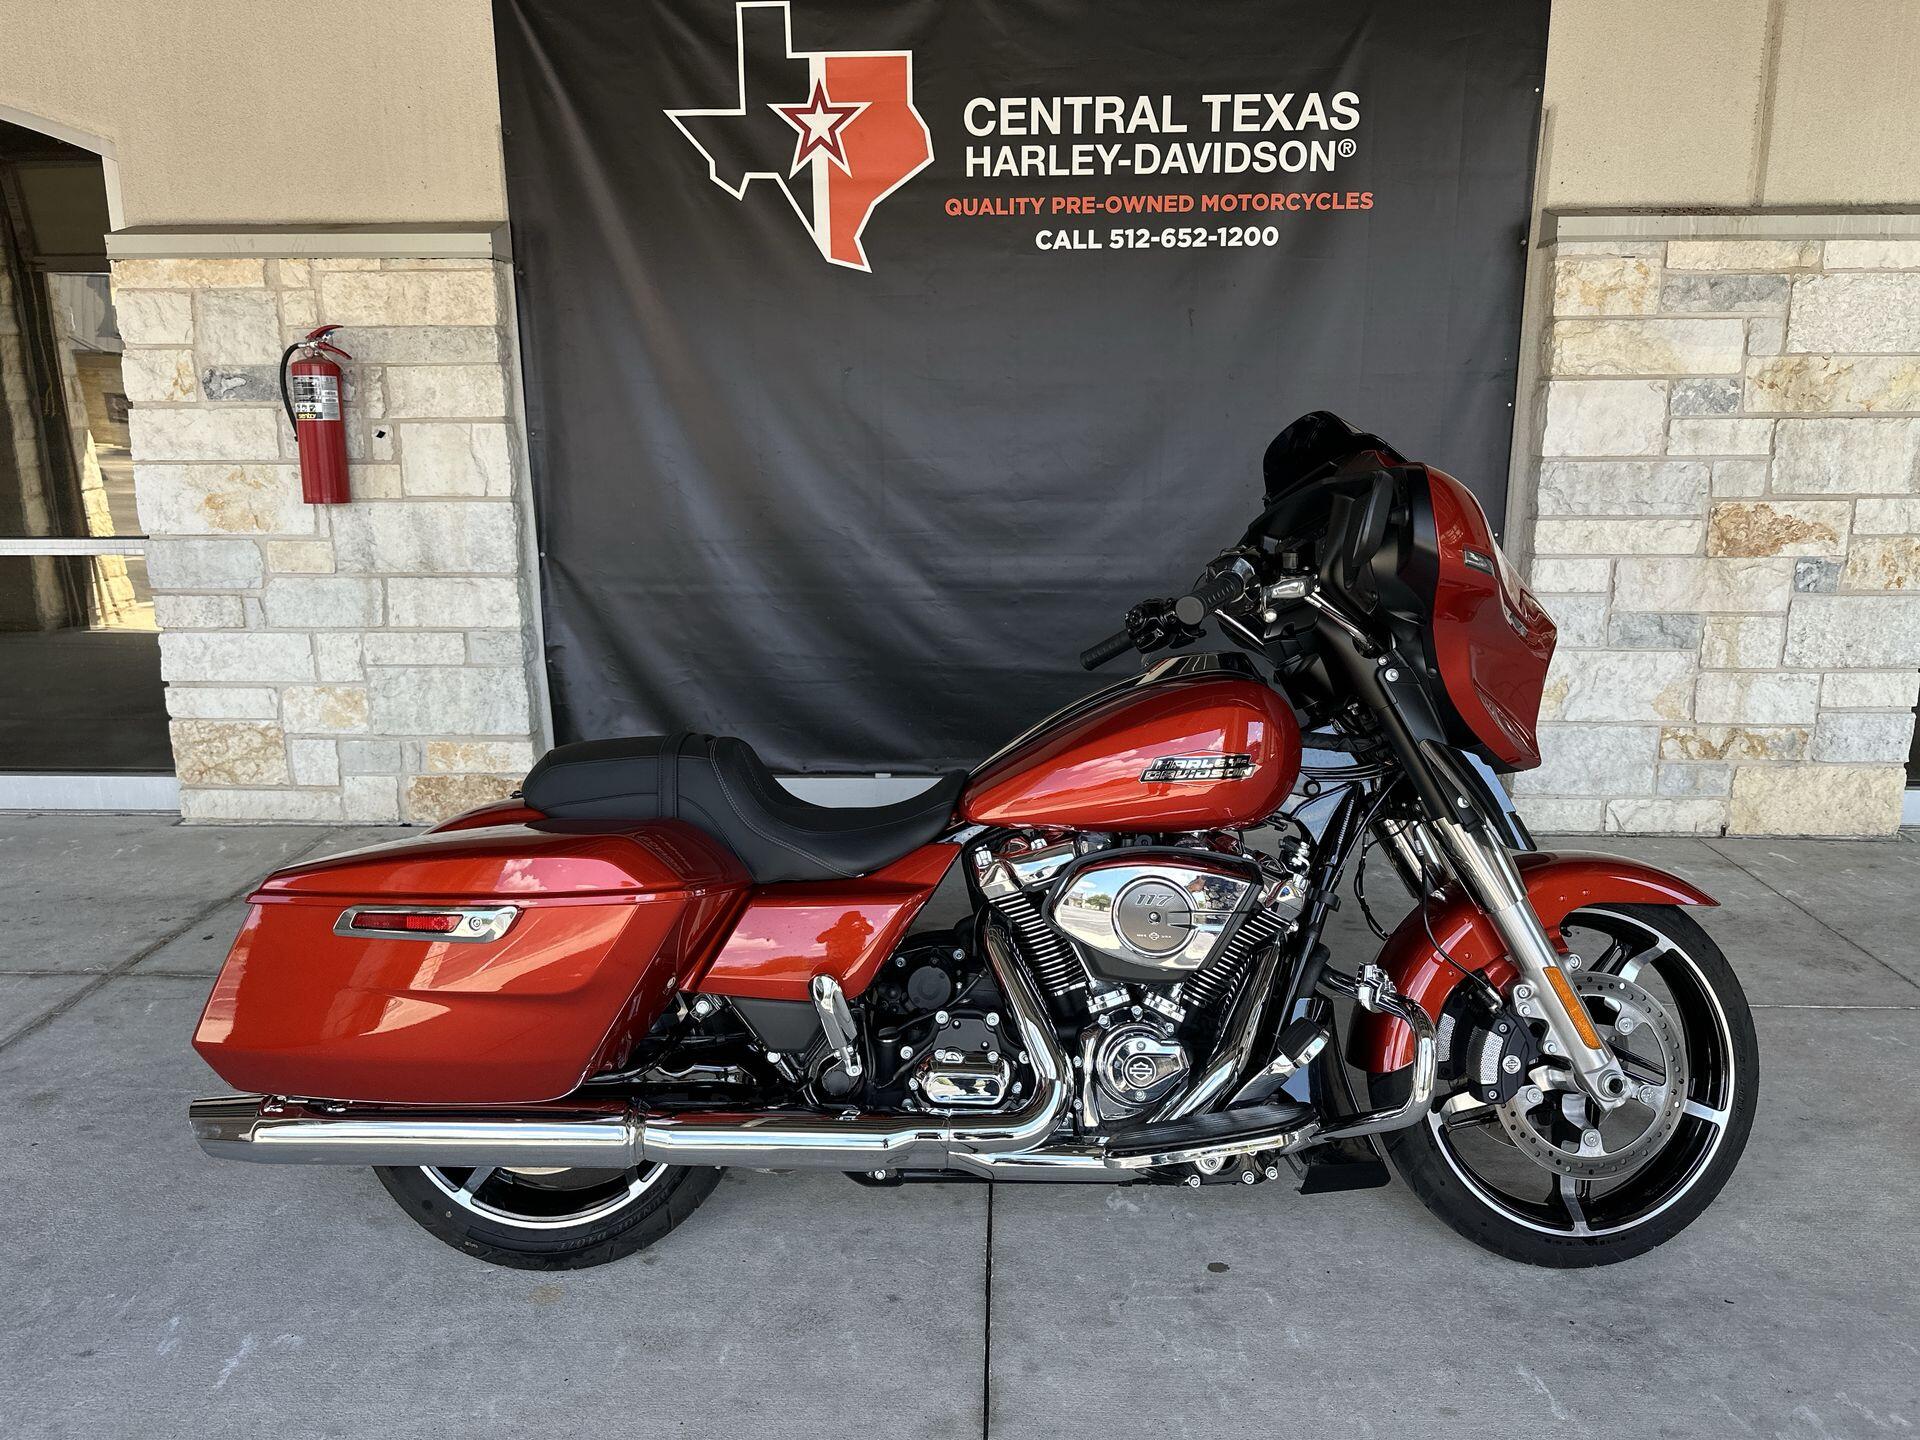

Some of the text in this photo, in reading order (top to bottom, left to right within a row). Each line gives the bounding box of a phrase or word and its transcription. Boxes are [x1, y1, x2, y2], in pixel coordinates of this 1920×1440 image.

[963, 91, 1360, 137] CENTRAL TEXAS
[944, 191, 1374, 217] QUALITY PRE-OWNED MOTORCYCLES
[1035, 225, 1280, 250] CALL 512-652-1200
[1135, 893, 1175, 907] 117
